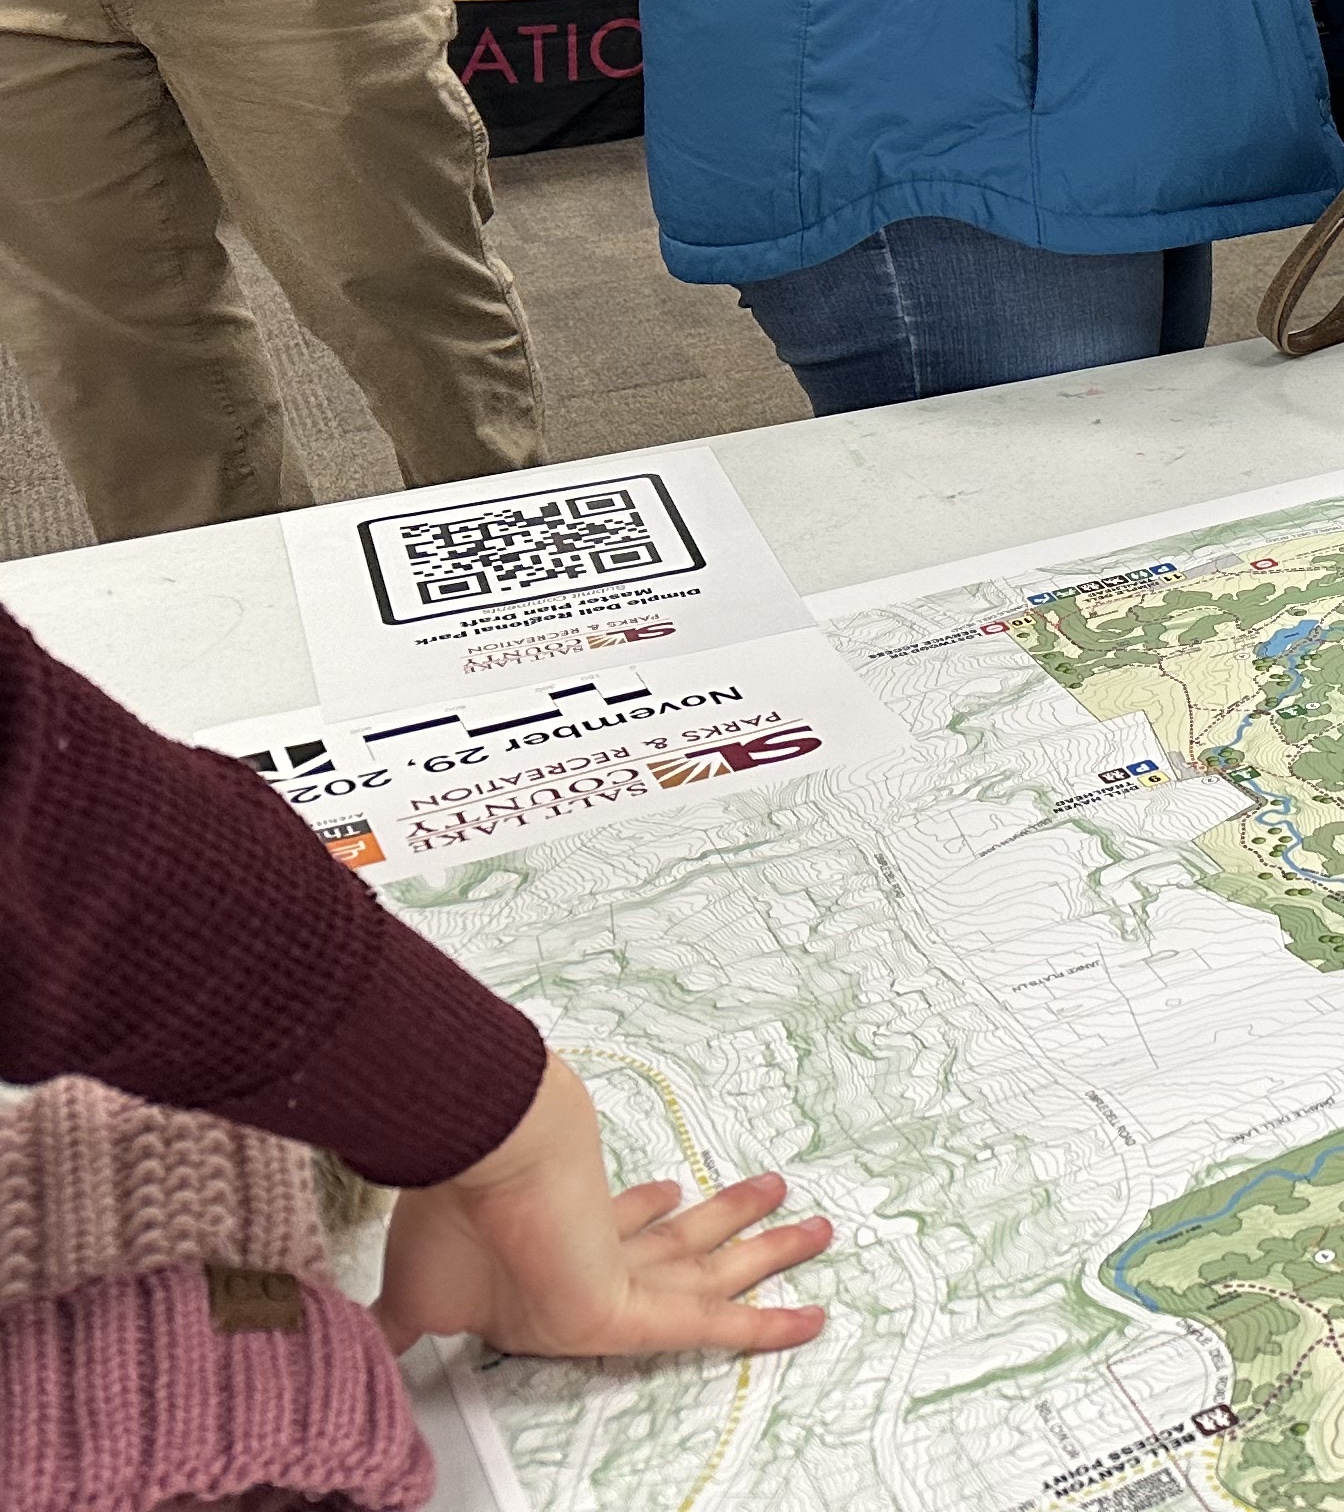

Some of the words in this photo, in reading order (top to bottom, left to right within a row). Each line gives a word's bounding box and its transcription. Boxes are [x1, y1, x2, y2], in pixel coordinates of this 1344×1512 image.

[461, 18, 644, 85] ATIO
[1165, 573, 1181, 582] 11
[578, 587, 652, 607] Master
[627, 588, 701, 607] Dimple
[460, 612, 510, 628] Draft
[530, 602, 571, 618] Plan
[579, 602, 621, 618] Dell
[607, 614, 659, 628] PARKS
[1011, 616, 1033, 628] 10
[474, 611, 572, 635] Regional
[606, 622, 676, 643] SL
[414, 630, 467, 647] Park
[468, 628, 579, 655] RECREATION
[464, 639, 581, 665] COUNTY
[504, 685, 743, 754] November
[683, 709, 782, 743] PARKS
[641, 737, 667, 752] &
[685, 725, 823, 774] SL
[408, 746, 487, 775] 29,
[411, 747, 630, 812] RECREATION
[1103, 785, 1140, 797] DELL
[406, 766, 640, 838] COUNTY
[546, 780, 649, 820] SALT
[1053, 797, 1102, 814] HAVEN
[1056, 782, 1134, 807] TRAILHEAD
[406, 813, 525, 855] LAKE
[1107, 1423, 1185, 1461] ACCESS
